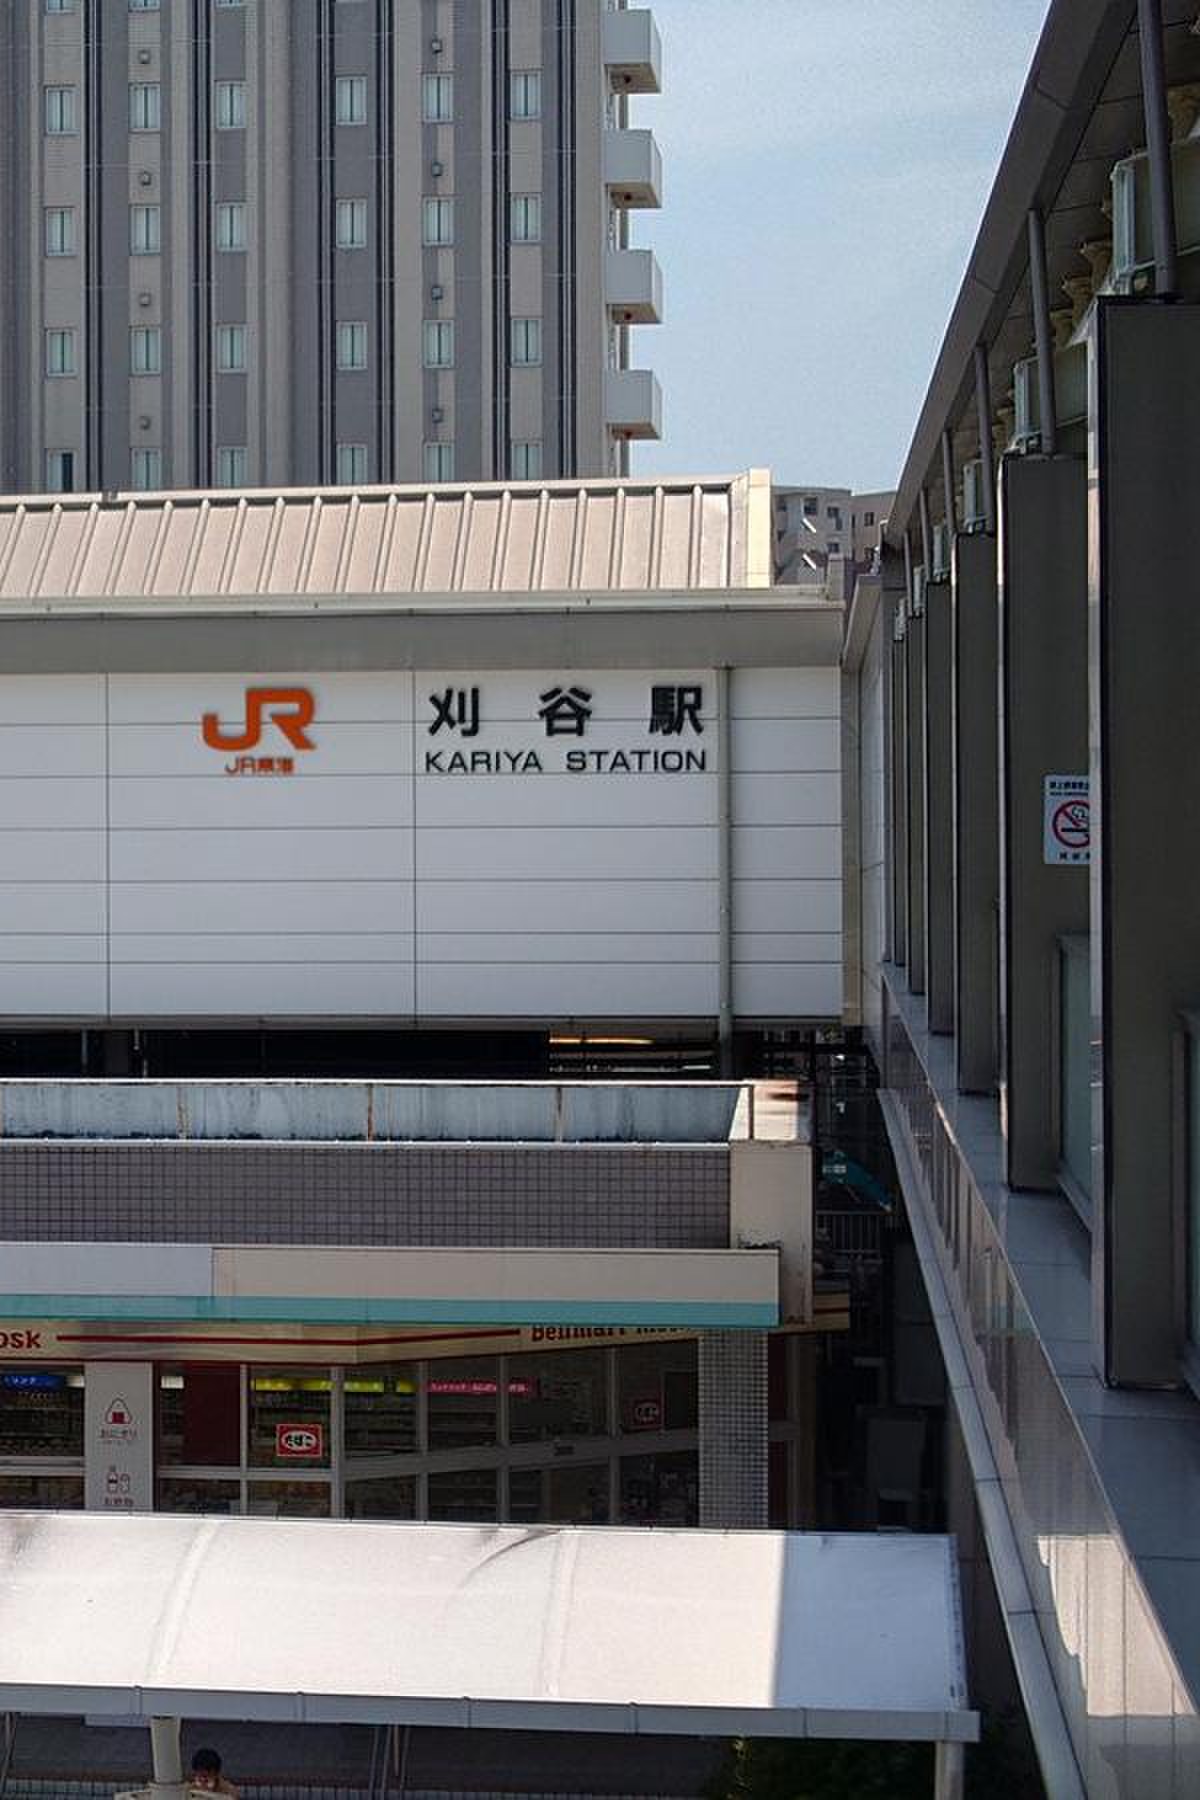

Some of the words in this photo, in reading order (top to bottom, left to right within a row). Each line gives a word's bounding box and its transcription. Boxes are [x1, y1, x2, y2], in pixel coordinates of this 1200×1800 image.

[202, 687, 317, 752] JR
[427, 685, 705, 737] 刈谷駅
[224, 756, 296, 777] JR東海
[425, 750, 543, 773] KARIYA
[565, 750, 707, 773] STATION
